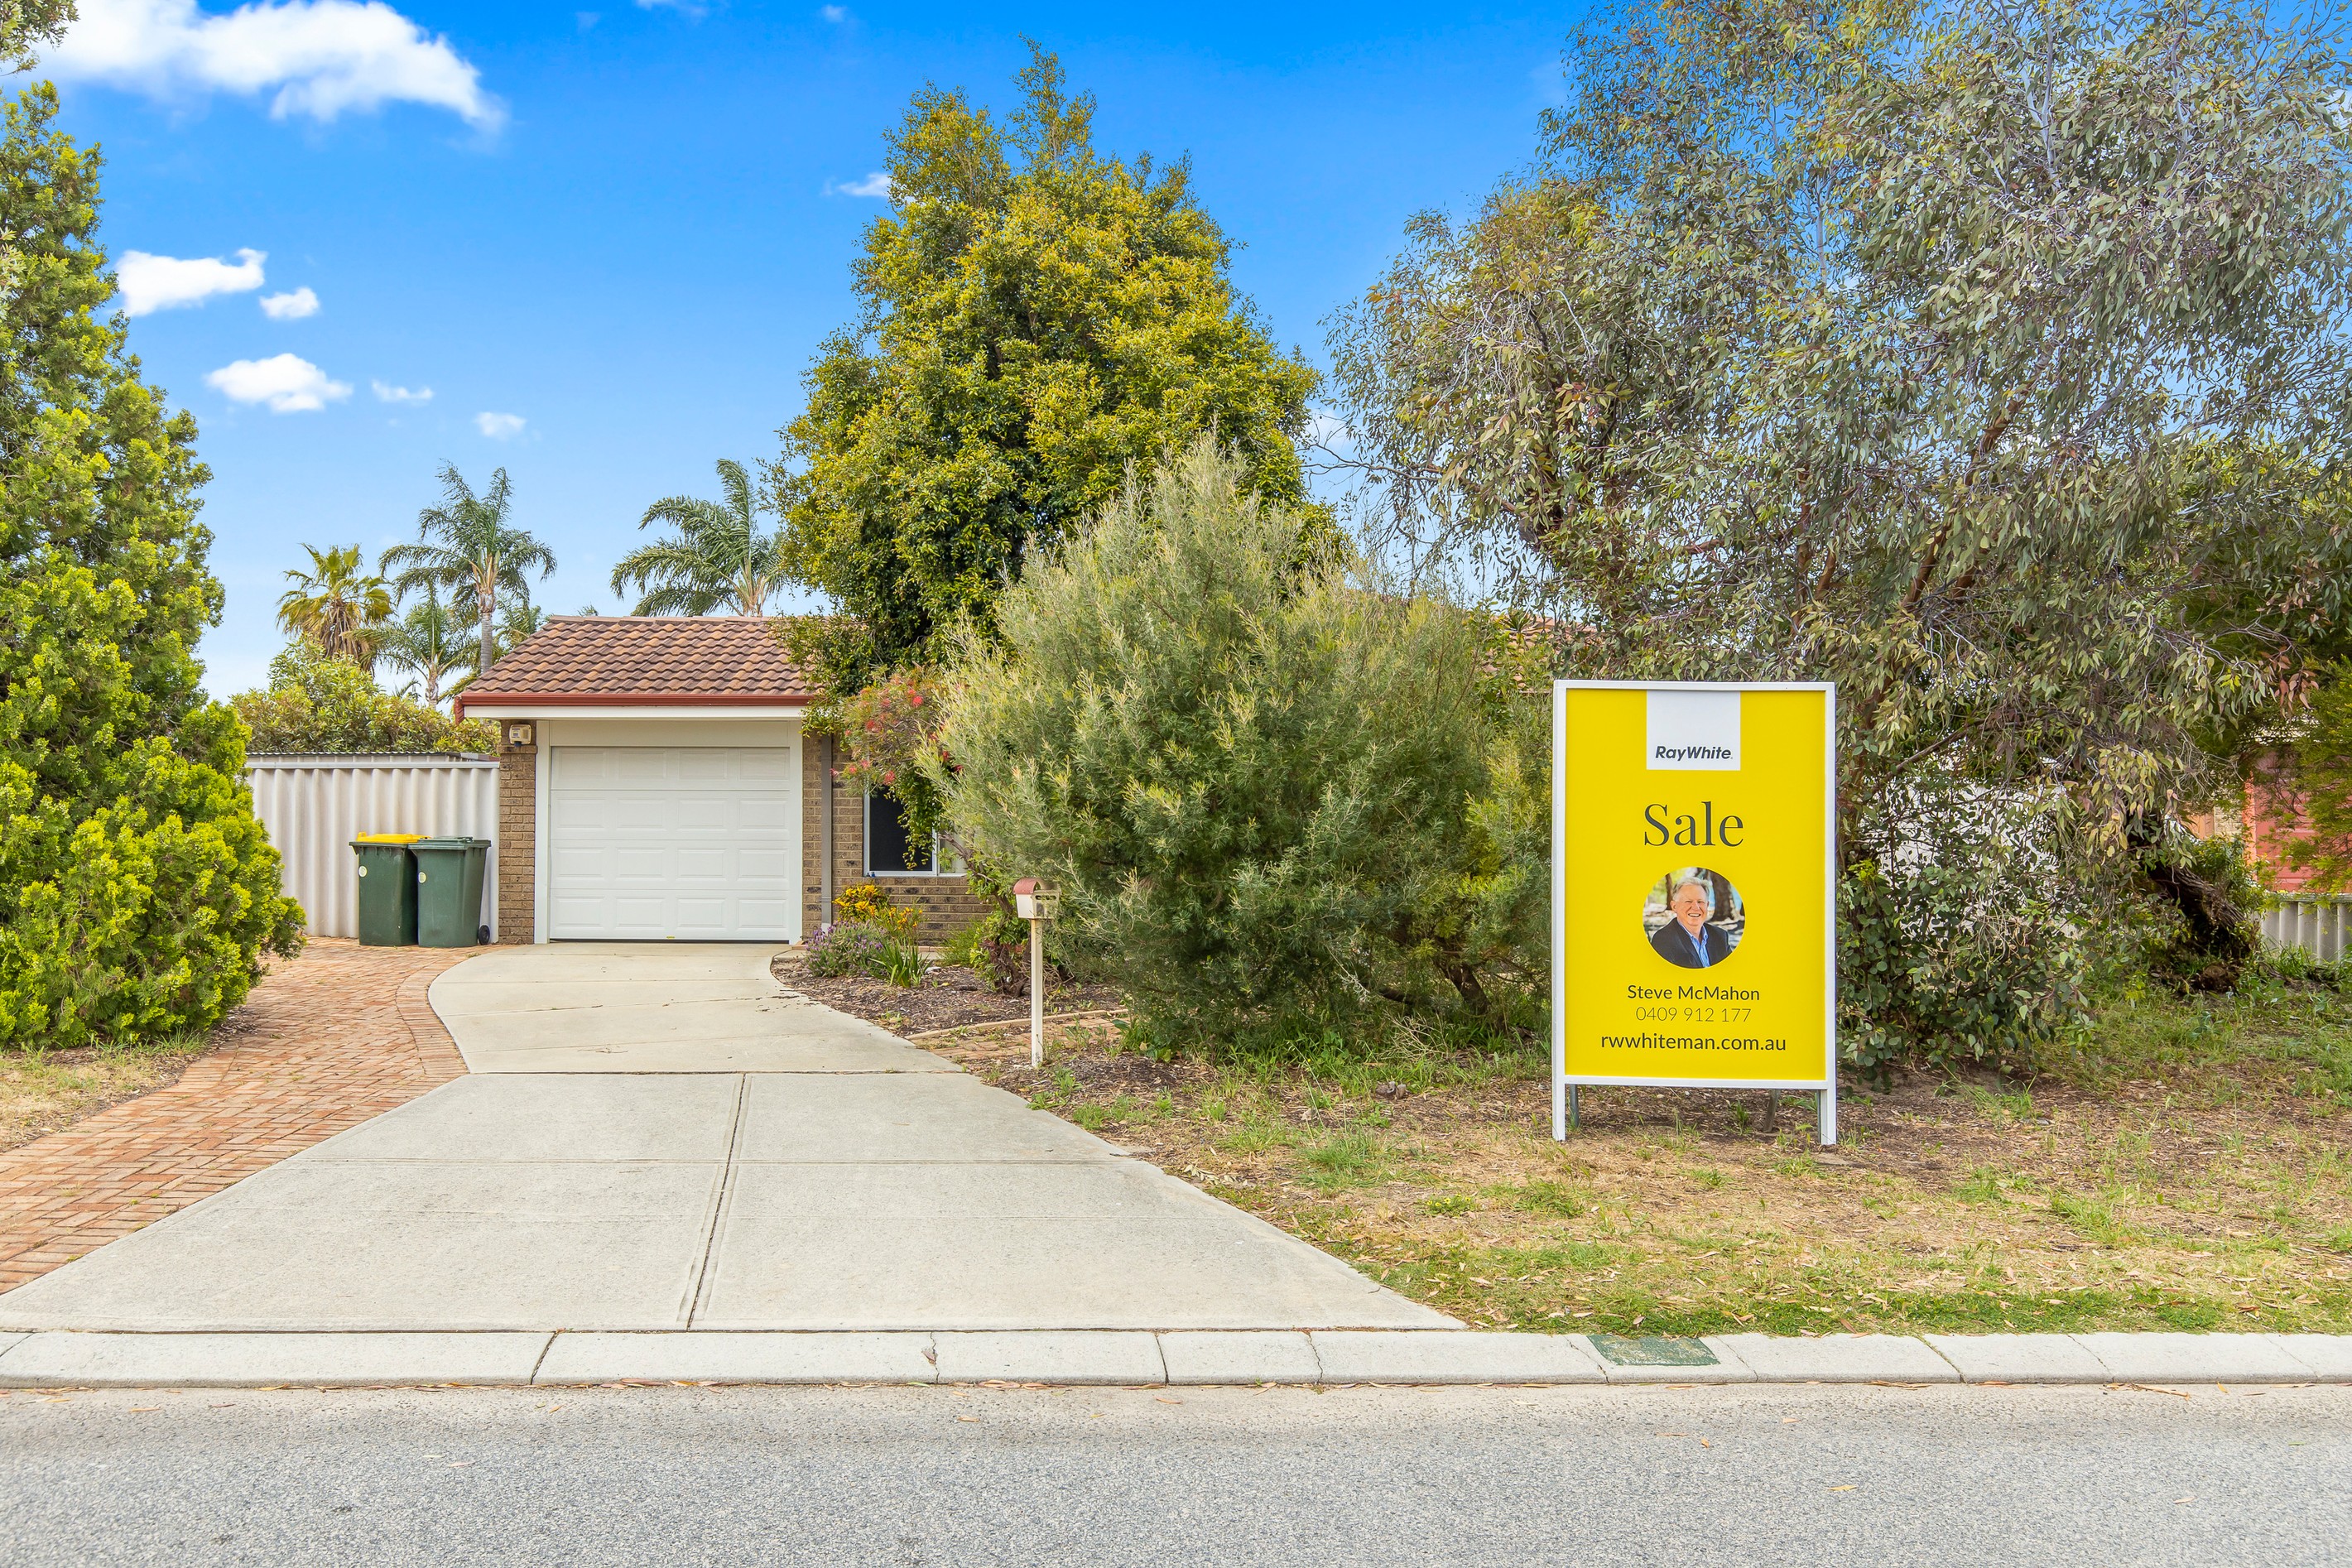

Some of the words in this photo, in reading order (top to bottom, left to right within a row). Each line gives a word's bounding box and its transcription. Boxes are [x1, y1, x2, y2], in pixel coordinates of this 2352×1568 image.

[1644, 801, 1744, 847] Sale
[1627, 984, 1672, 999] Steve
[1678, 985, 1760, 1000] McMahon
[1635, 1007, 1677, 1021] 0409
[1683, 1008, 1715, 1022] 912
[1721, 1008, 1752, 1022] 177
[1601, 1032, 1787, 1051] rwwhiteman.com.au
